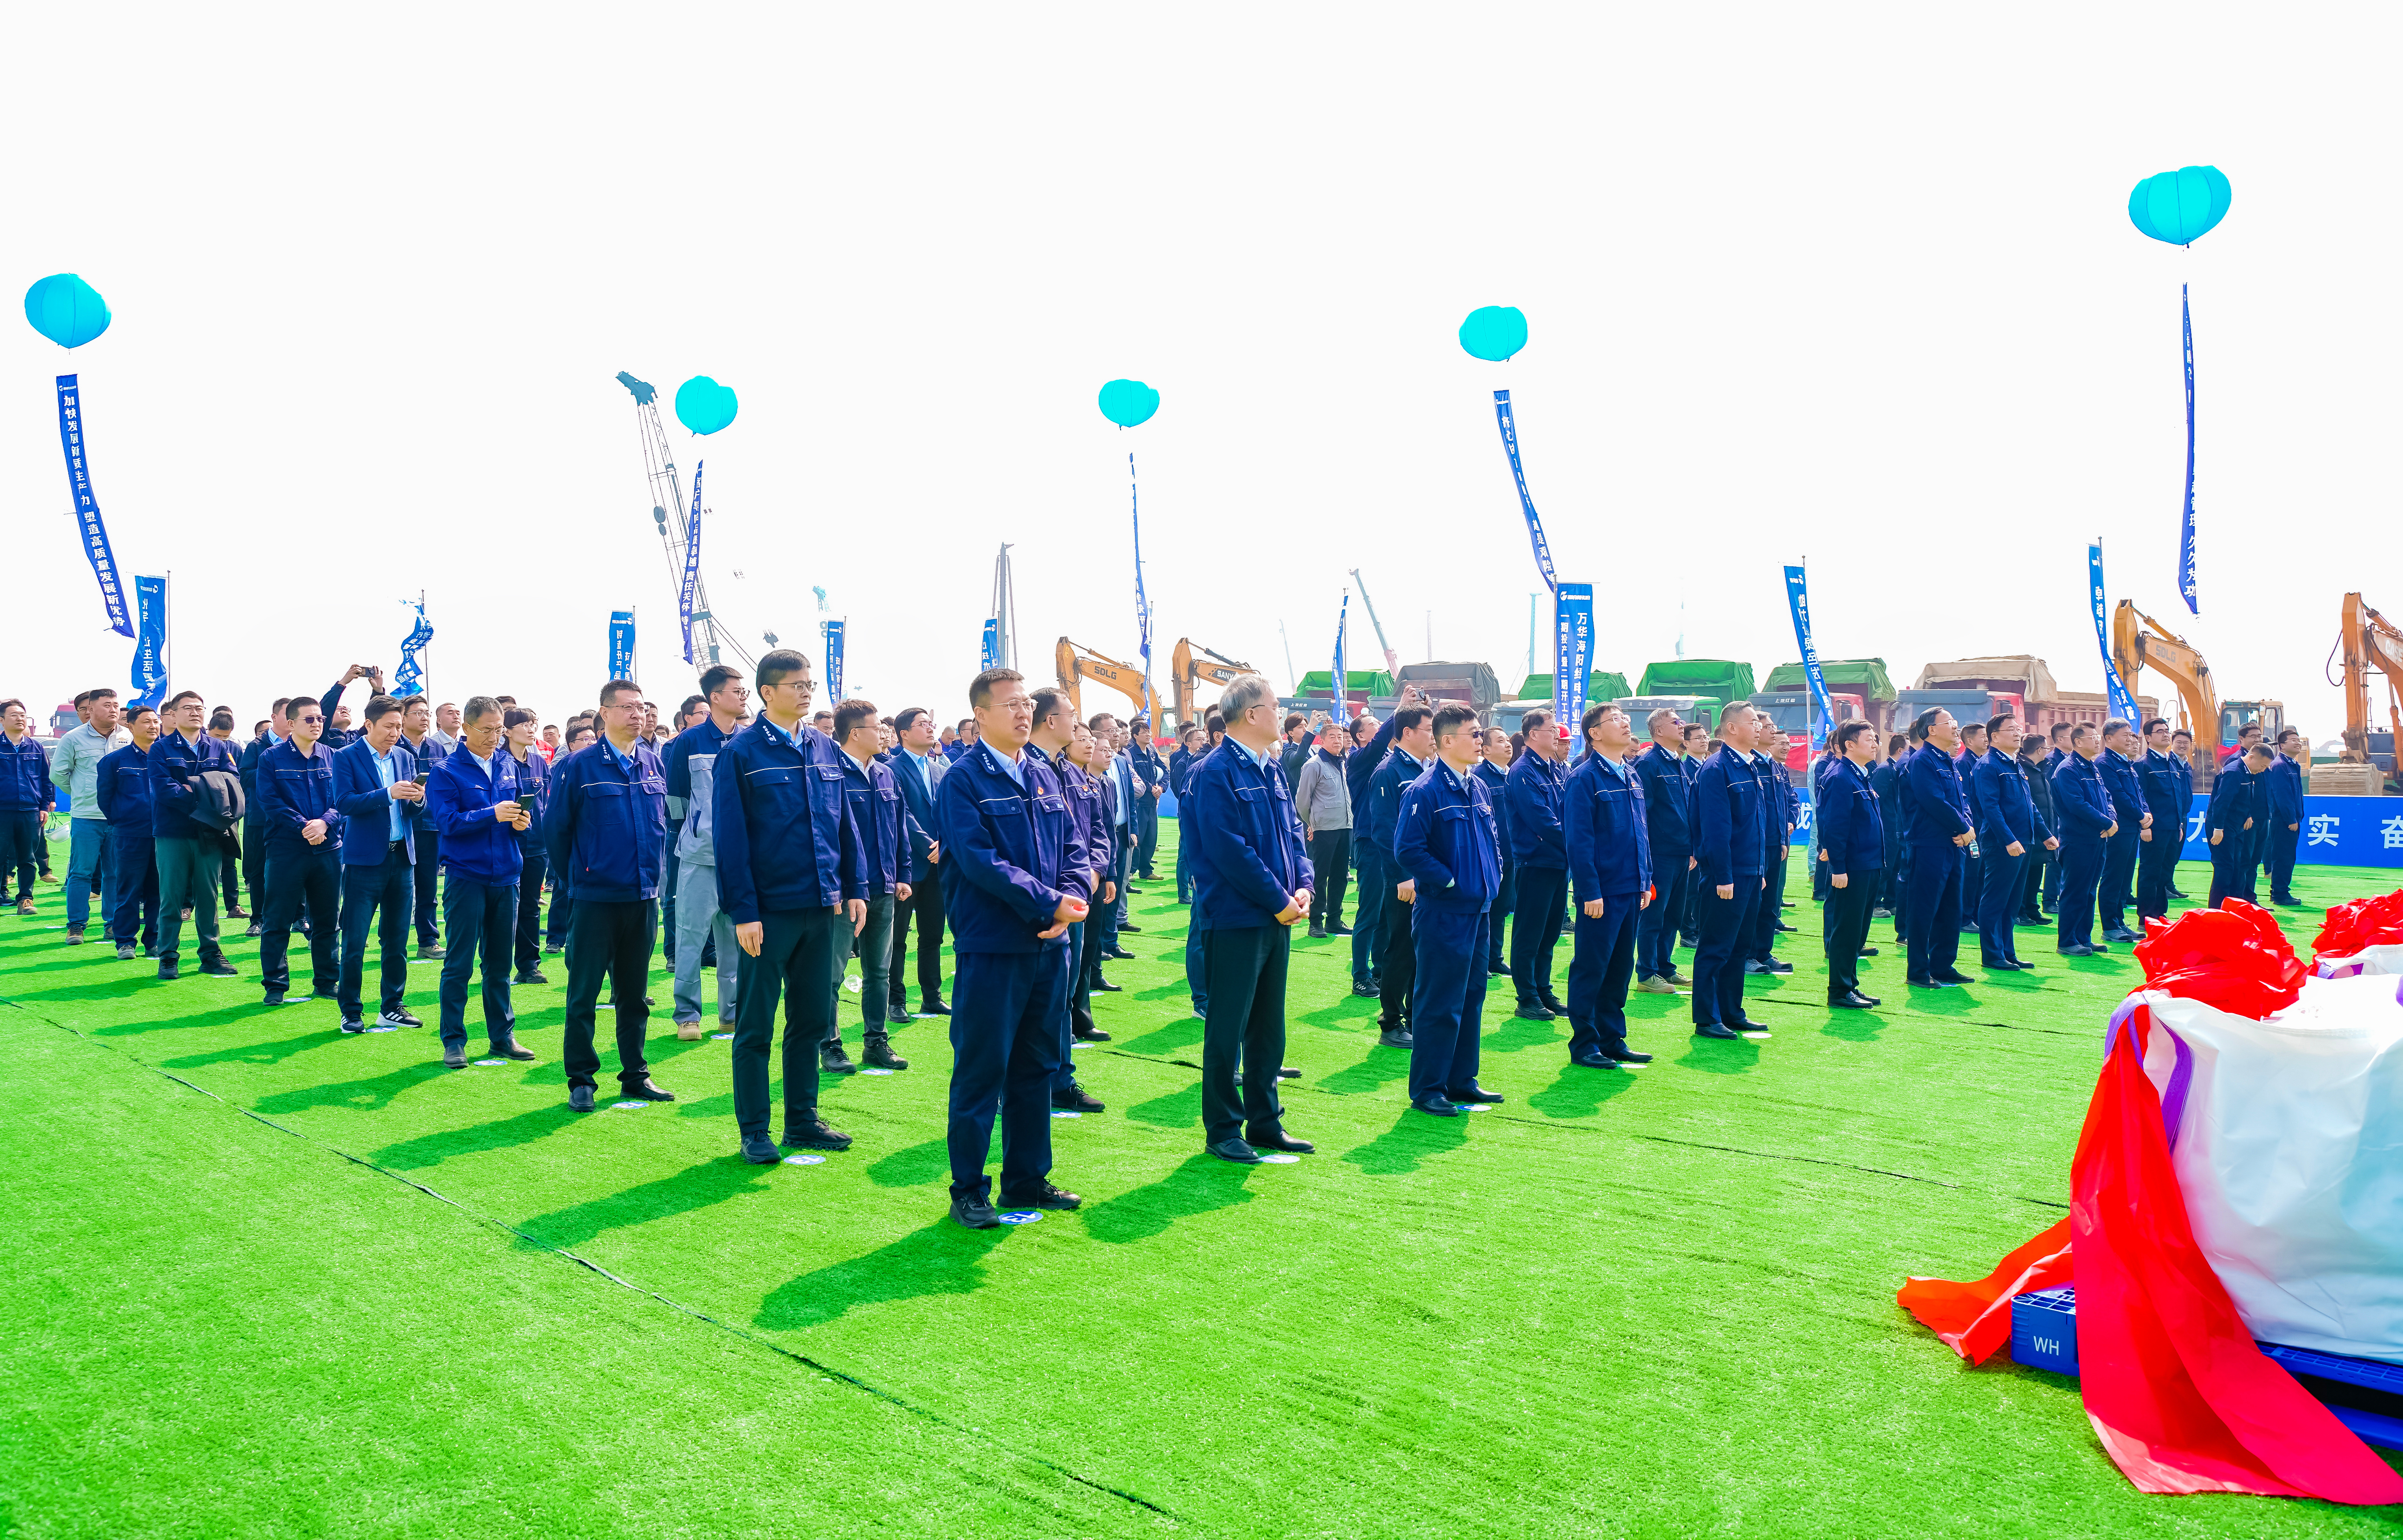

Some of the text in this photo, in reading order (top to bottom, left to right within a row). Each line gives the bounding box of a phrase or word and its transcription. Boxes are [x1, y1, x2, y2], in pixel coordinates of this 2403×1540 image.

[64, 395, 90, 506] 加快发展新质生产力
[84, 511, 125, 626] 塑造高质量发展新优势
[2156, 644, 2176, 663] SDLG
[2385, 639, 2403, 663] CASE
[1094, 666, 1116, 680] SDLG
[2308, 814, 2339, 846] 实
[789, 1156, 819, 1164] 13
[1002, 1214, 1036, 1223] 13
[2034, 1335, 2059, 1356] WH
